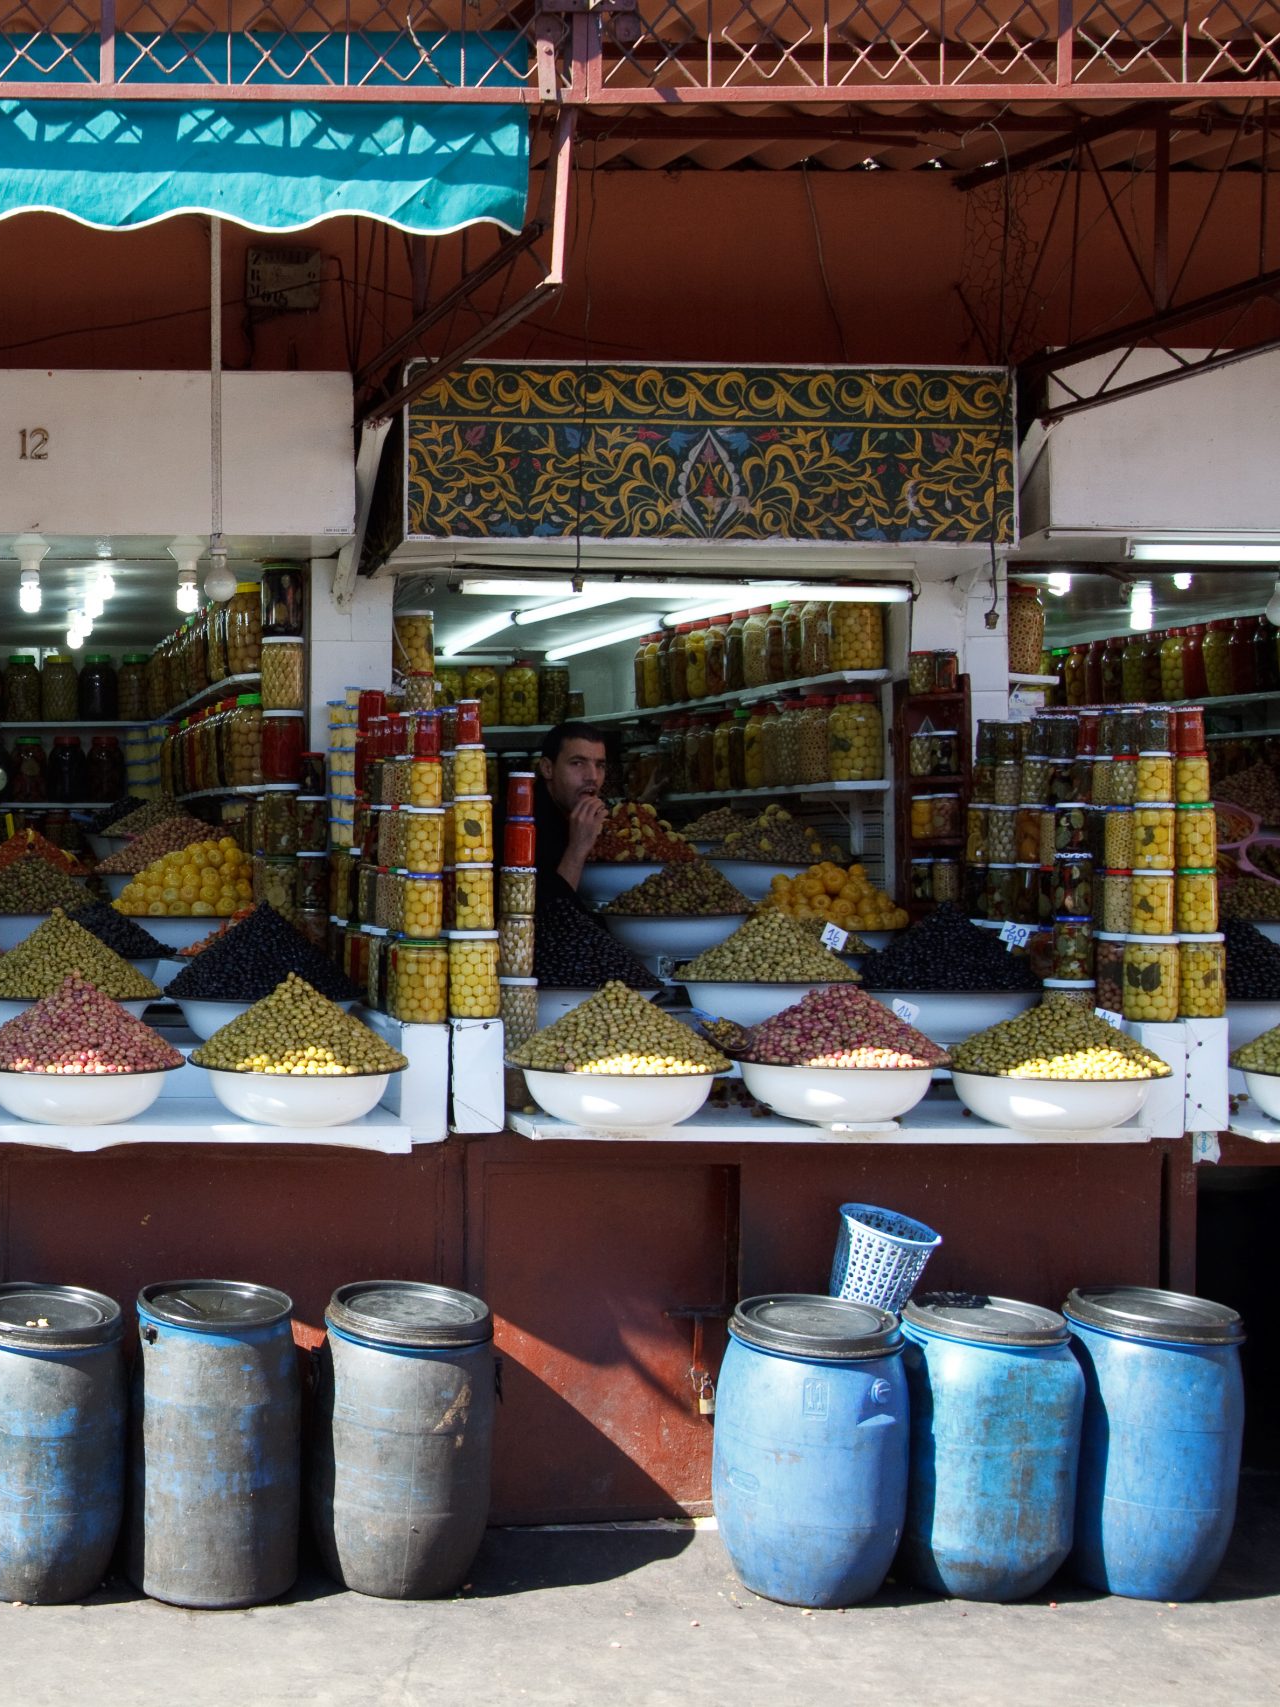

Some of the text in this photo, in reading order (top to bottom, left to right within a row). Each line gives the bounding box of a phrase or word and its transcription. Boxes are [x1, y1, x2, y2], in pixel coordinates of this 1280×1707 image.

[18, 428, 49, 460] 12
[826, 928, 841, 943] 16
[1004, 924, 1026, 938] 20
